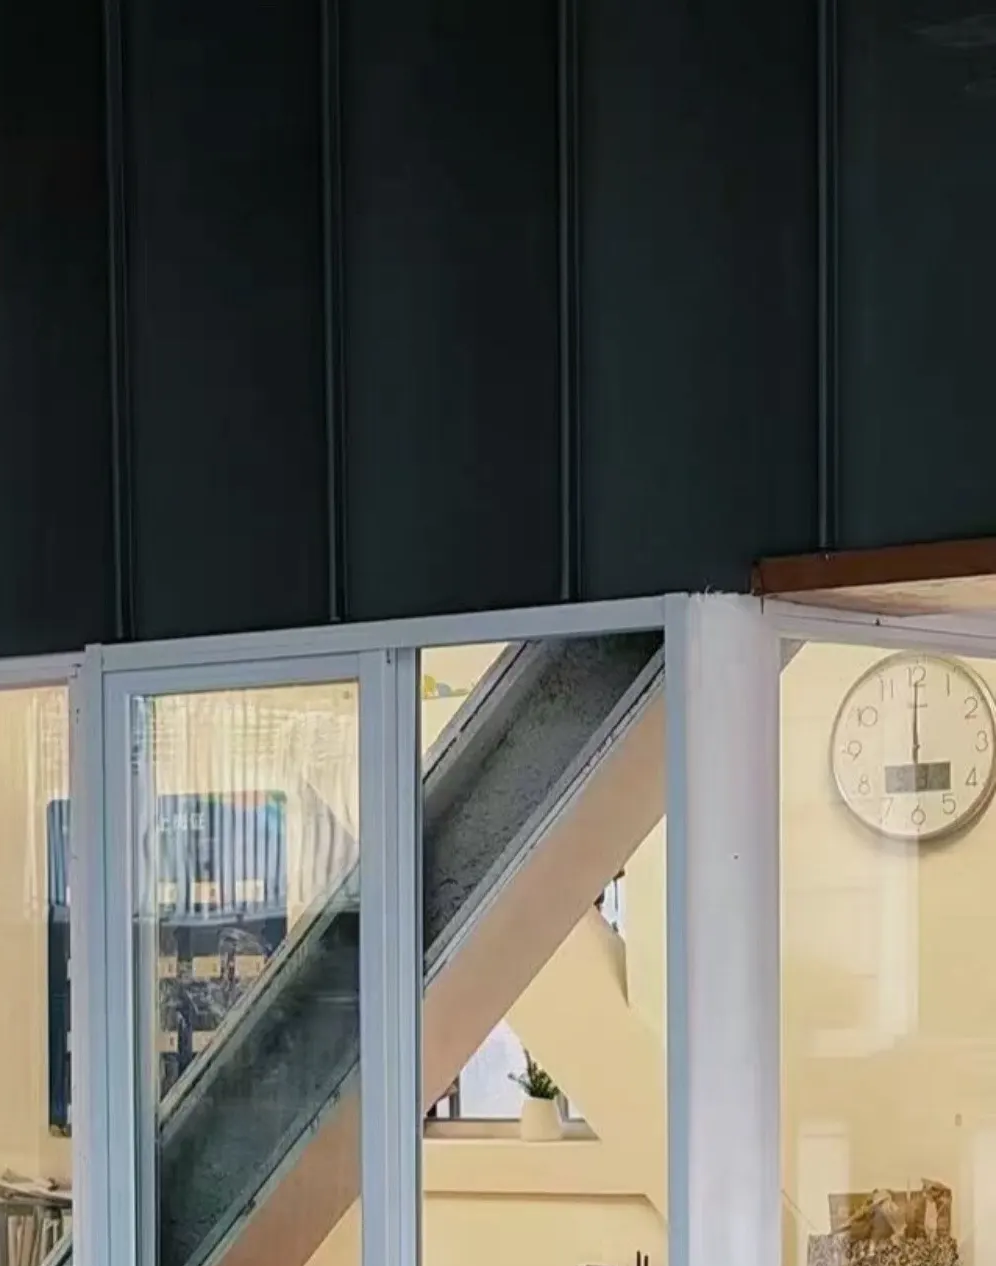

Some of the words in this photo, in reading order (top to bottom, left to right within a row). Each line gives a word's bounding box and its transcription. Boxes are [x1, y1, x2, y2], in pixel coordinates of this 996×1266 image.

[857, 706, 878, 727] 10
[964, 697, 978, 719] 2
[975, 731, 989, 752] 3
[858, 775, 871, 795] 8
[965, 767, 977, 787] 4
[911, 802, 926, 826] 6
[942, 793, 957, 815] 5
